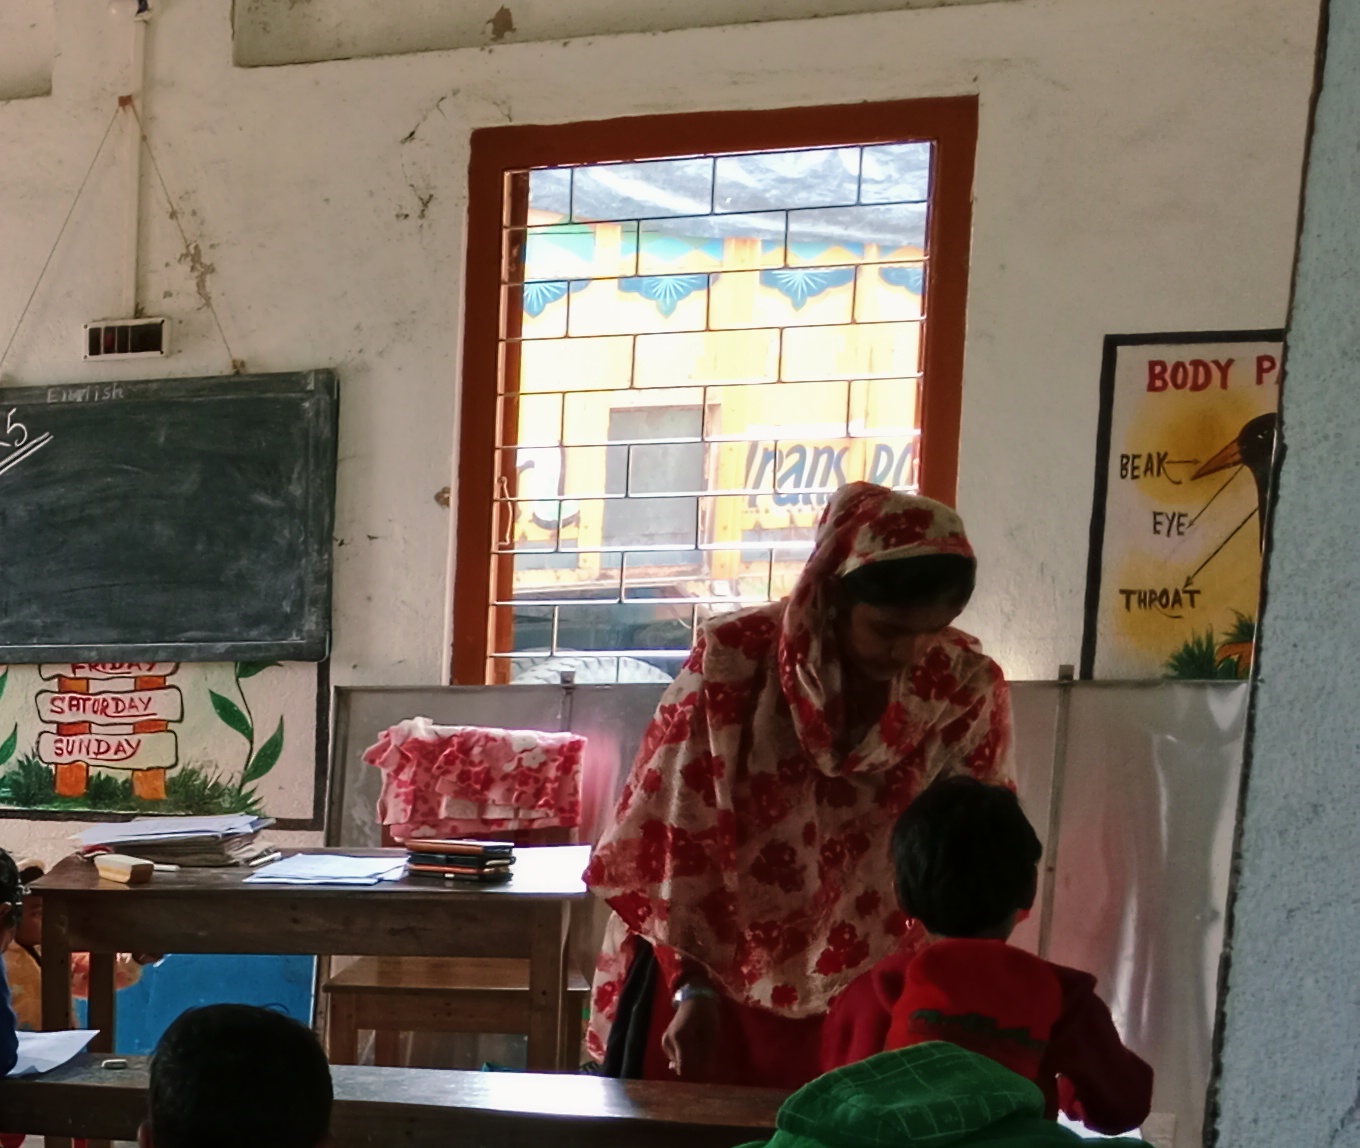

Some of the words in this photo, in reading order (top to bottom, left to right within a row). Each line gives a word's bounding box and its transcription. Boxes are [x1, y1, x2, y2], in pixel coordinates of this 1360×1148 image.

[1146, 357, 1235, 393] BODY
[1119, 451, 1171, 481] BEAK
[1151, 510, 1189, 537] EYE
[1118, 588, 1201, 615] THROAT
[54, 738, 142, 759] SUNDAY
